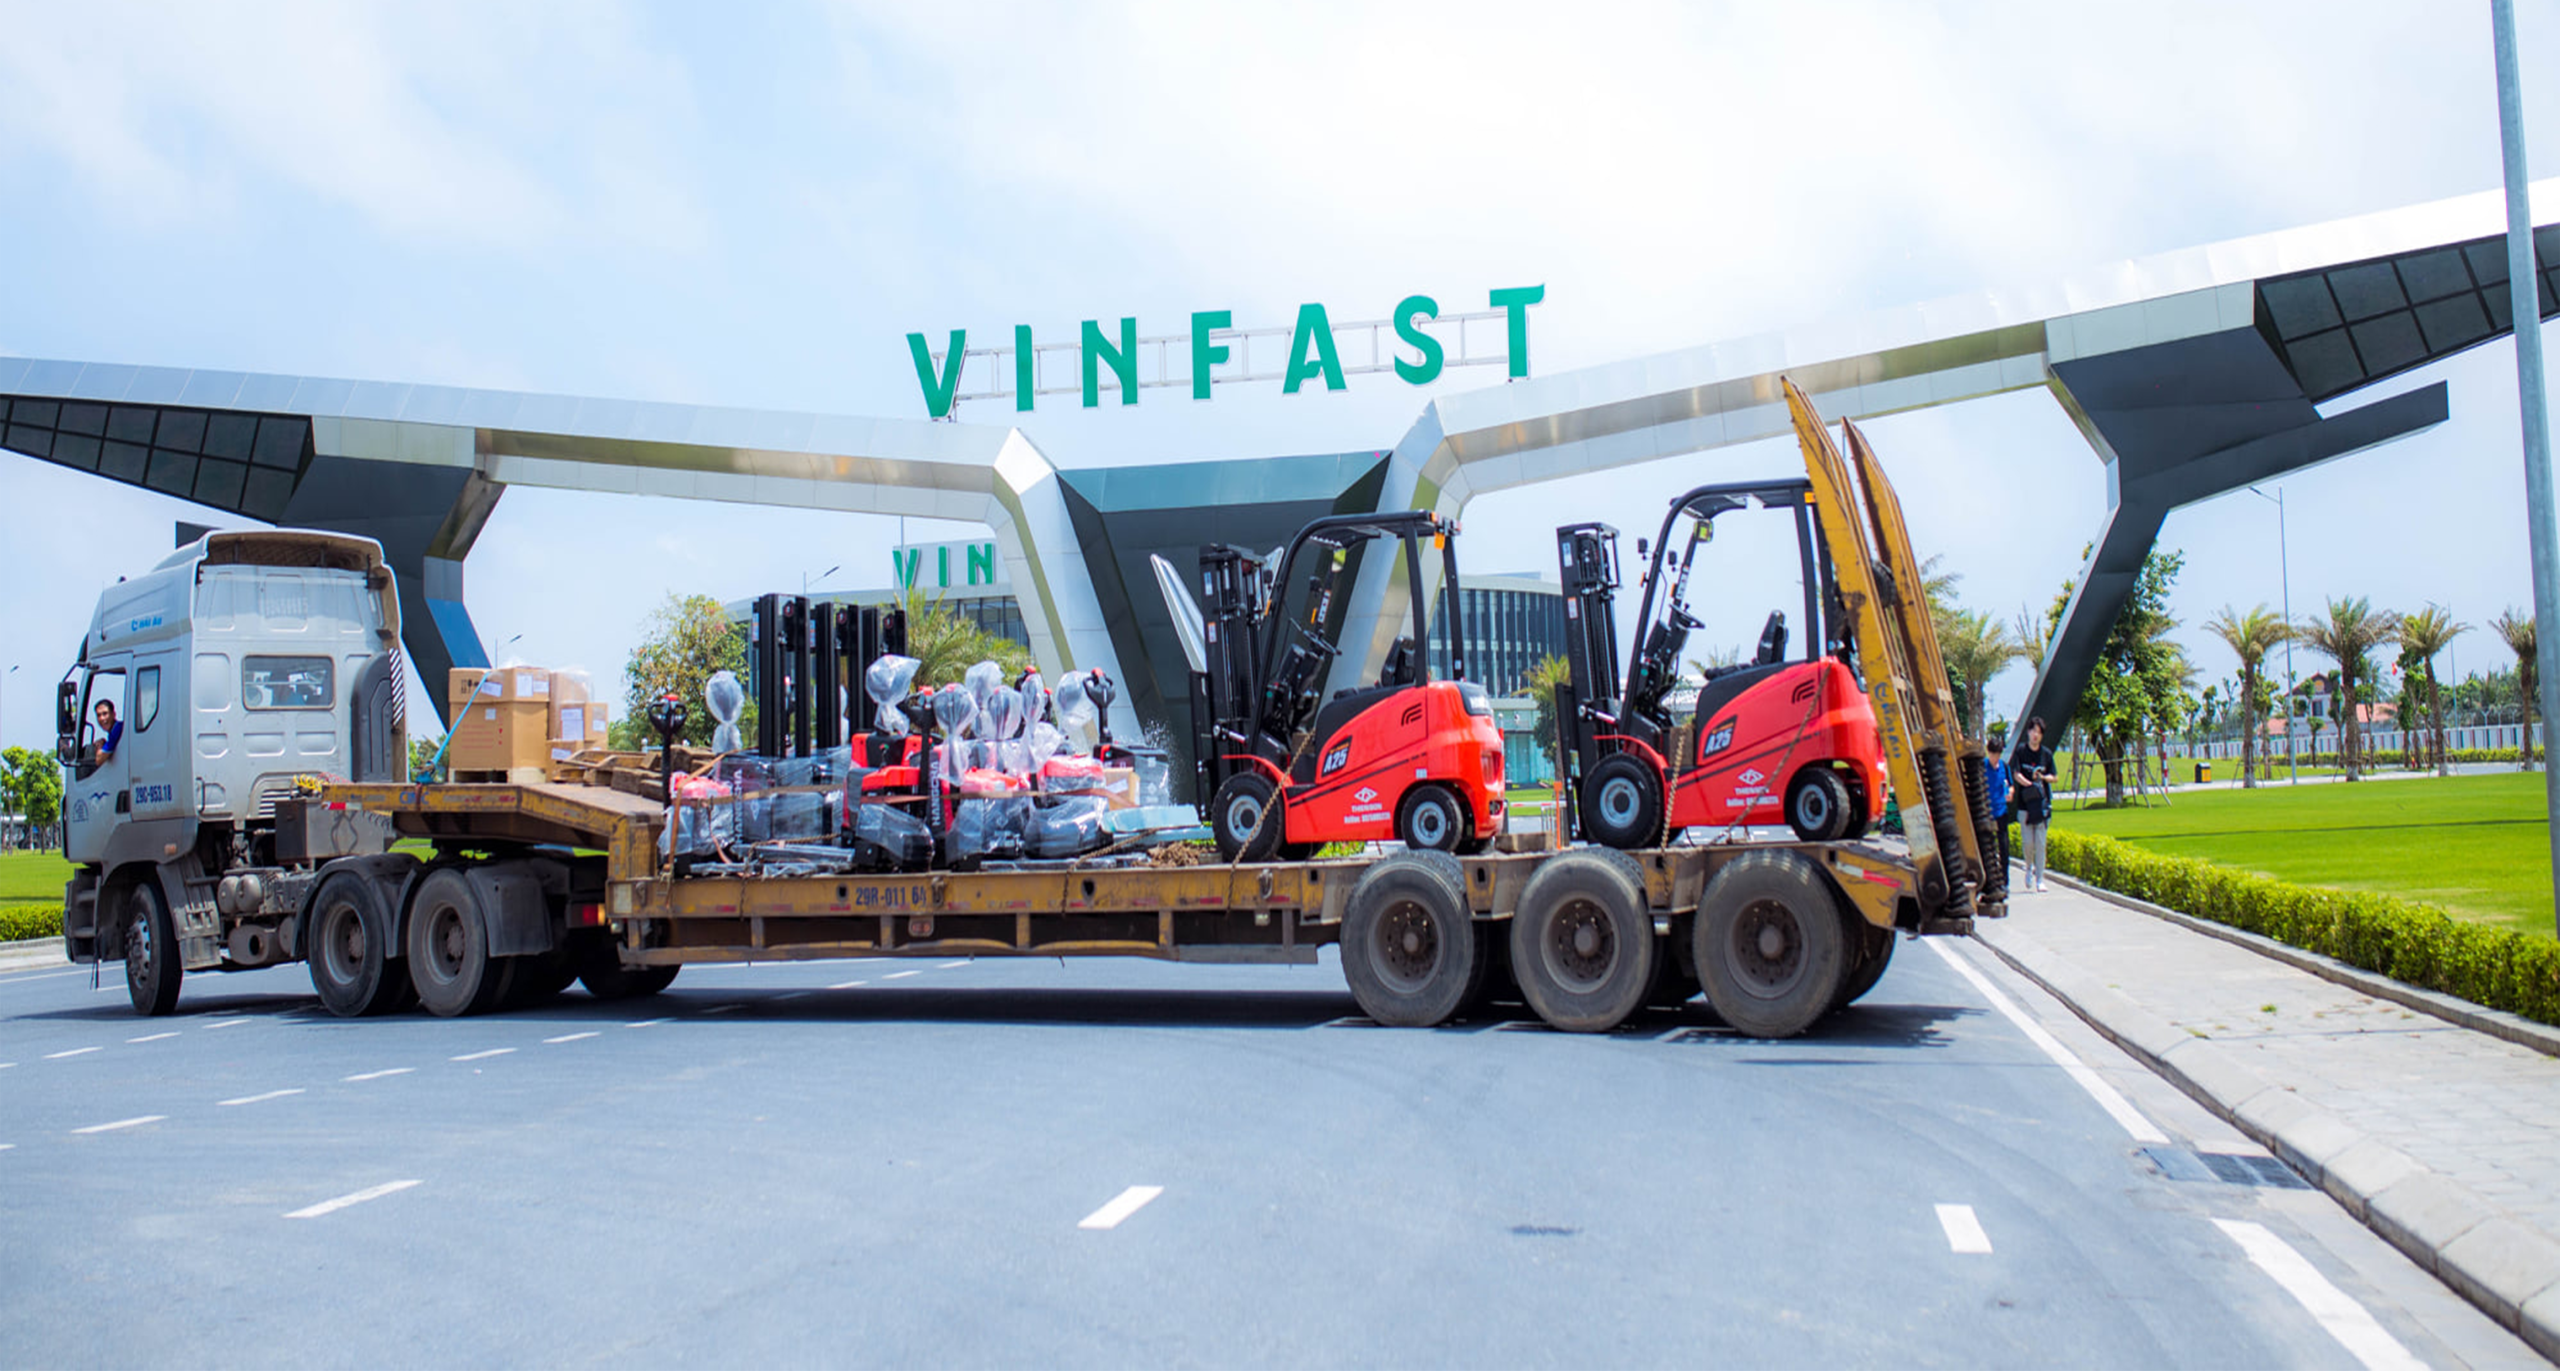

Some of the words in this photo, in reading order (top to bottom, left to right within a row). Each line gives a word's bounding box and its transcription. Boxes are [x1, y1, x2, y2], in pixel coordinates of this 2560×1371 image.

[906, 284, 1545, 419] VINFAST
[1323, 747, 1349, 773] A25
[1703, 727, 1733, 754] A25
[931, 761, 941, 826] HANGCHA
